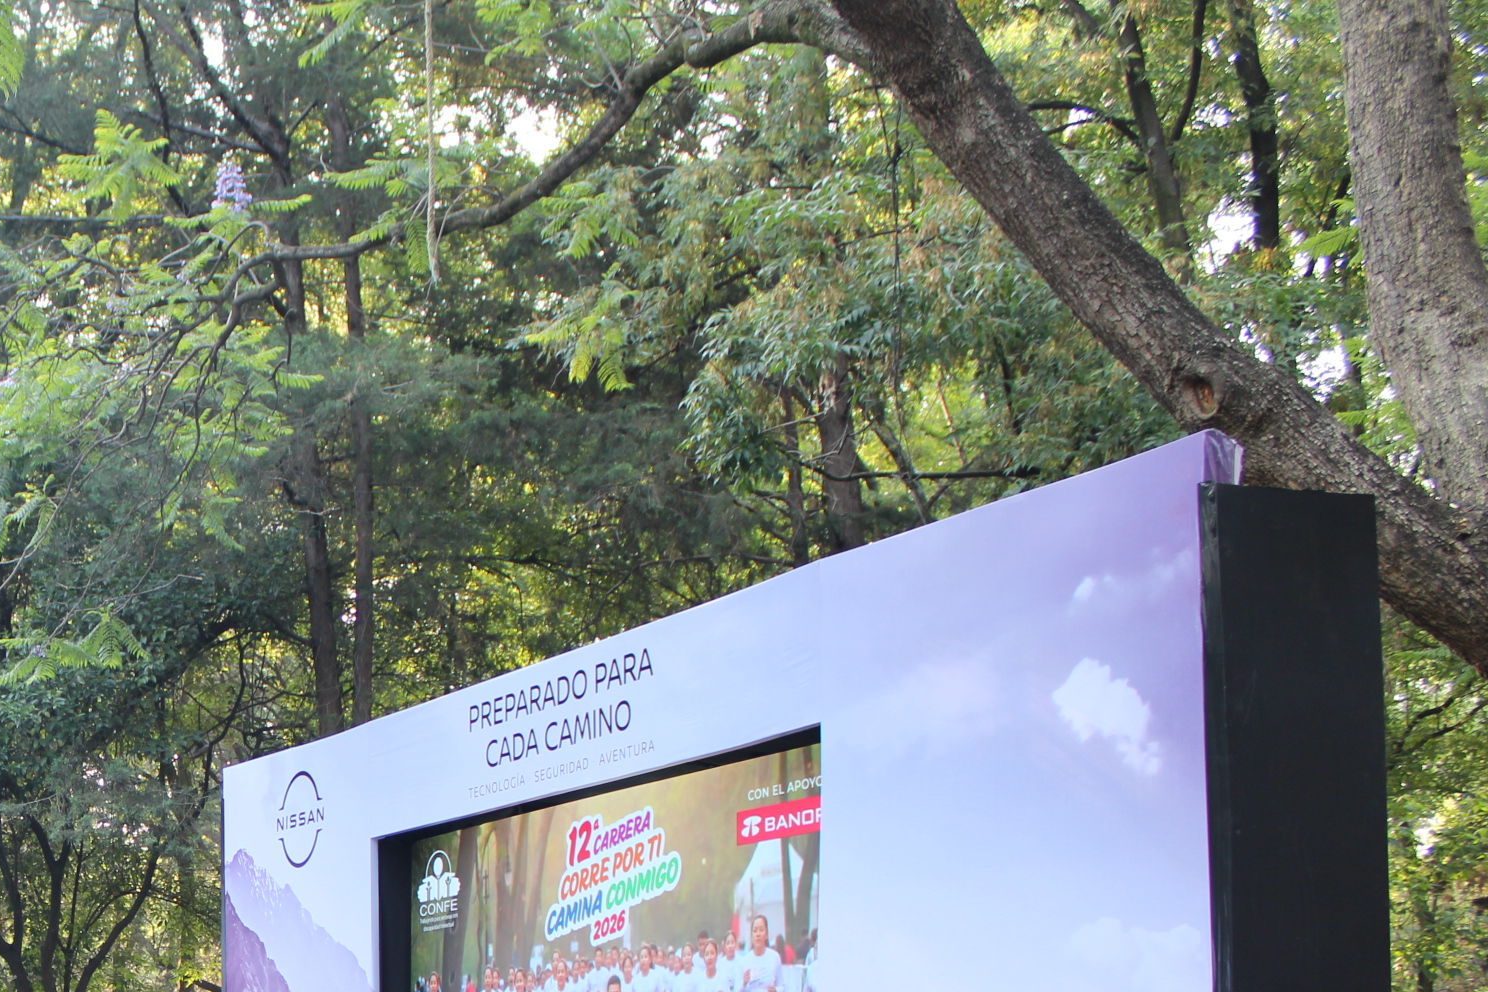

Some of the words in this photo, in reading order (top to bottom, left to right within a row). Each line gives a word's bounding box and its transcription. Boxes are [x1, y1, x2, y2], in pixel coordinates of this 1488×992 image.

[469, 669, 588, 733] PREPARADO
[594, 647, 654, 694] PARA
[485, 728, 540, 768] CADA
[544, 700, 632, 751] CAMINO
[468, 772, 526, 799] TECNOLOGÍA
[534, 757, 589, 783] SEGURIDAD
[598, 740, 655, 766] AVENTURA
[747, 786, 770, 801] CON
[772, 784, 785, 796] EL
[276, 806, 325, 832] NISSAN
[593, 811, 651, 856] CARRERA
[560, 857, 611, 901] CORRE
[612, 842, 645, 878] POR
[647, 833, 662, 862] TI
[419, 898, 458, 917] CONFE
[547, 889, 603, 936] CAMINA
[605, 857, 679, 910] CONMIGO
[593, 909, 626, 941] 2026
